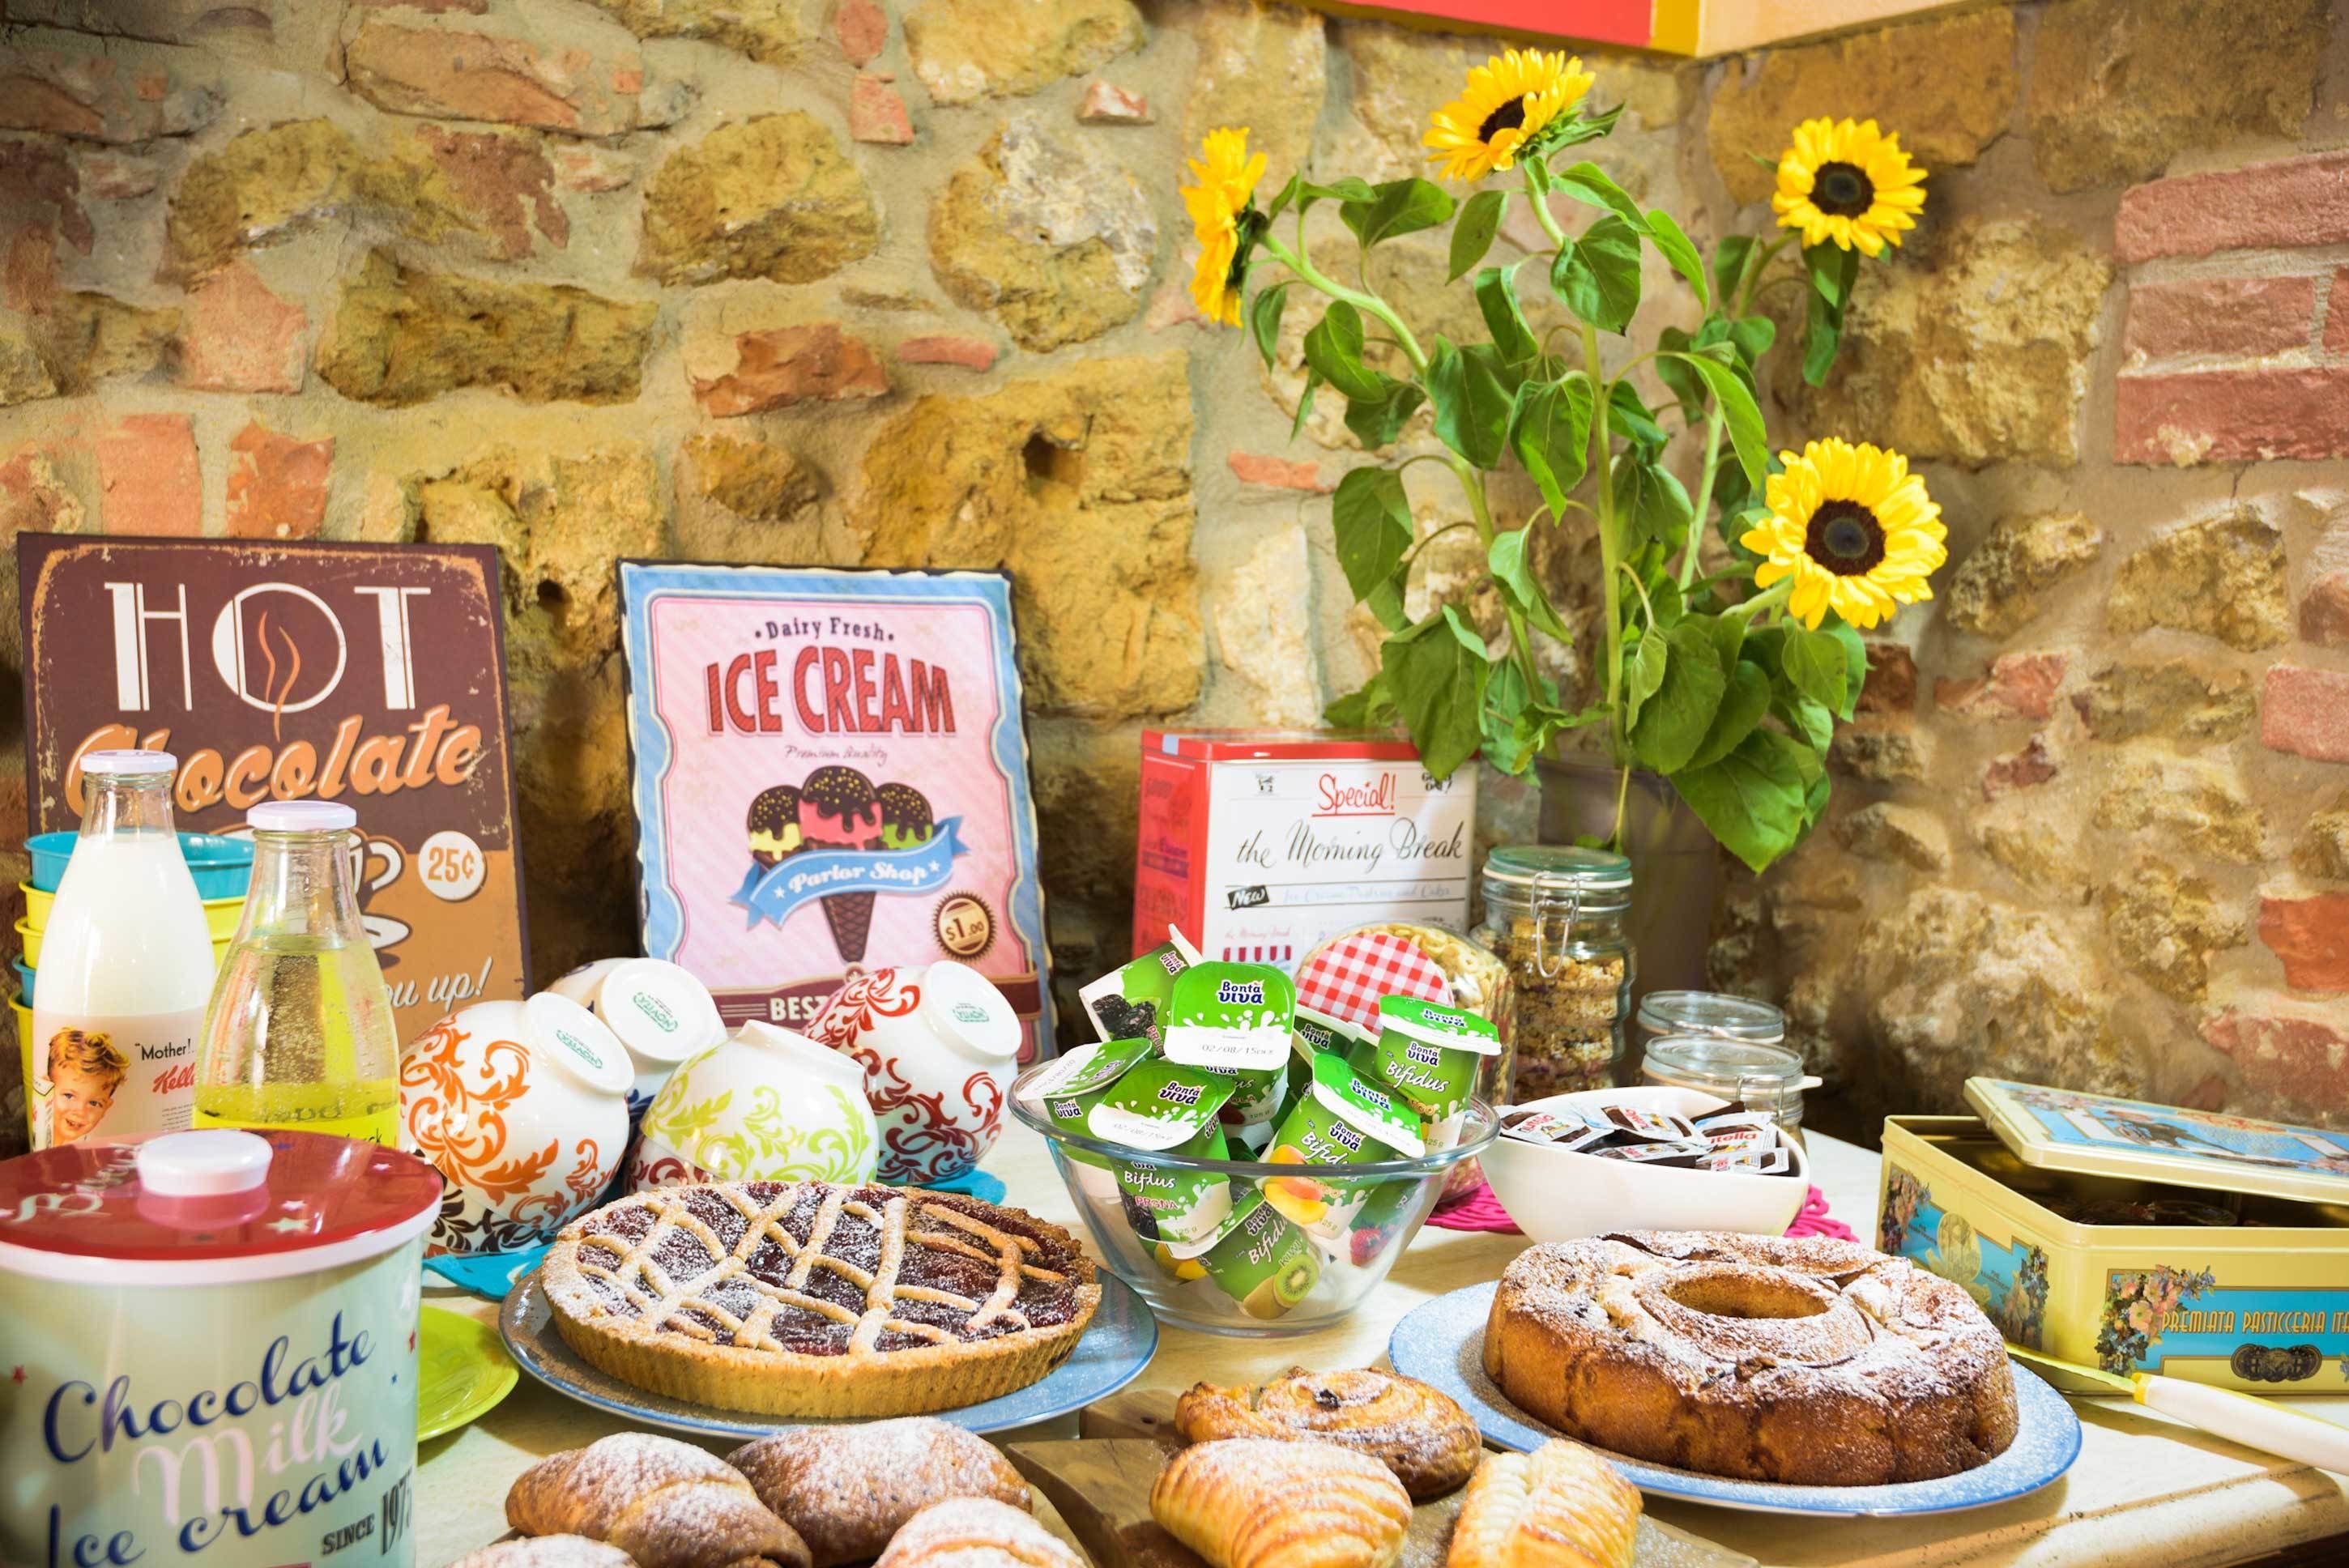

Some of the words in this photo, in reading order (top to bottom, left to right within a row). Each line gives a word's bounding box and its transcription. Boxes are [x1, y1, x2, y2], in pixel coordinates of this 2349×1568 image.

[765, 618, 821, 640] Dairy
[829, 617, 885, 641] Fresh
[104, 582, 431, 714] HOT
[706, 649, 783, 734] ICE
[793, 646, 957, 734] CREAM
[65, 704, 481, 818] Cocolate
[784, 743, 840, 760] Premium
[842, 742, 888, 768] Quality
[1317, 773, 1397, 815] Special!
[1236, 829, 1277, 869] the
[1285, 818, 1383, 875] Morning
[1388, 816, 1465, 861] Break
[428, 846, 475, 883] 25¢
[788, 863, 865, 894] Parlor
[868, 861, 928, 885] Shop
[945, 916, 984, 942] $1.00
[428, 956, 493, 1012] up!
[1218, 991, 1264, 1004] viva
[1386, 1060, 1450, 1093] Bifidus
[1407, 1049, 1439, 1067] viva
[152, 1062, 195, 1095] Kell
[1160, 1090, 1198, 1105] viva
[1330, 1127, 1360, 1151] viva
[1248, 1217, 1287, 1264] Bifidu
[2162, 1310, 2236, 1334] PREMIATA
[2242, 1310, 2326, 1334] PASTICCERIA
[44, 1309, 376, 1464] Chocolate
[131, 1378, 363, 1528] Milk
[46, 1502, 147, 1568] Ice
[179, 1437, 390, 1552] cream
[322, 1513, 375, 1555] SINCE
